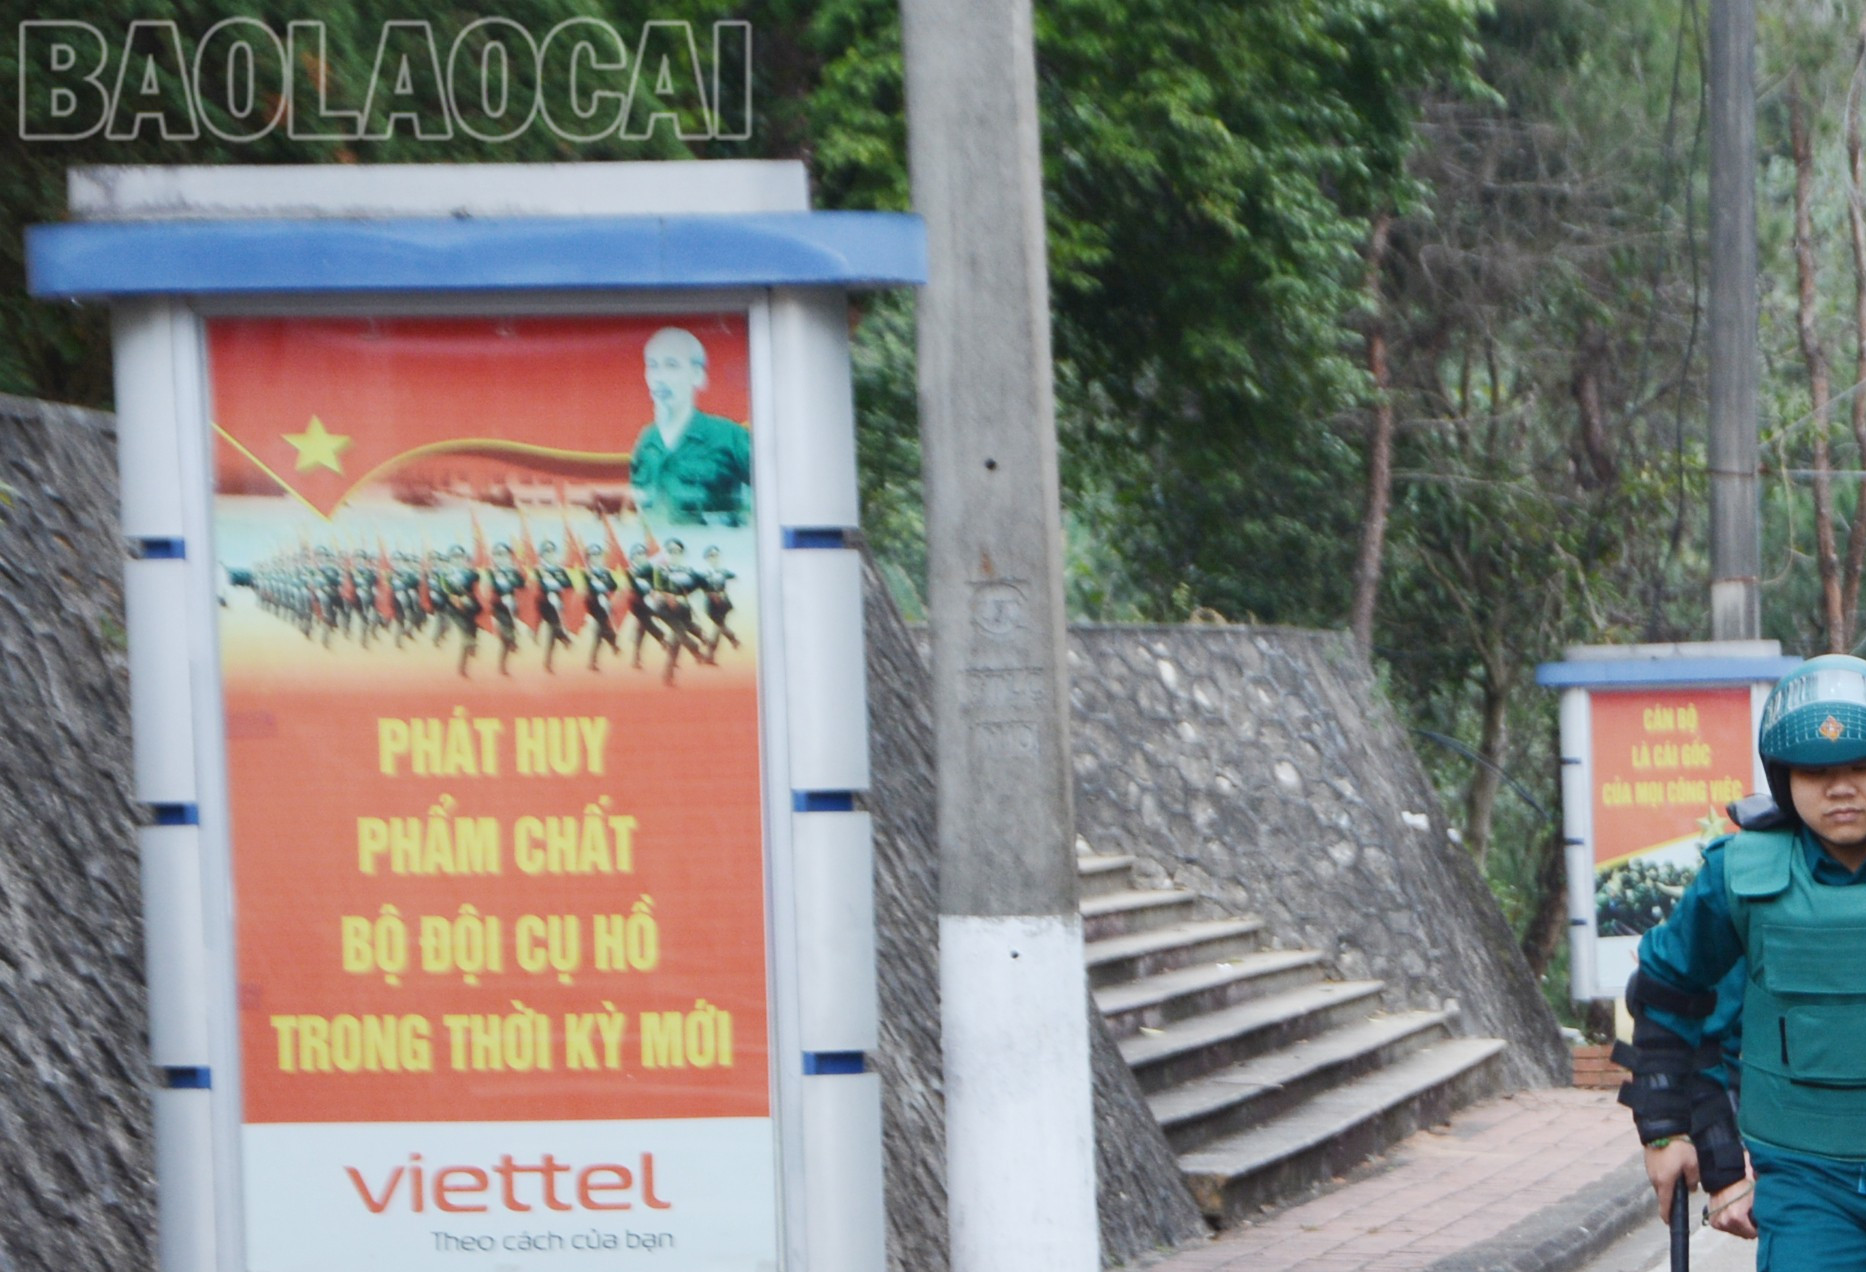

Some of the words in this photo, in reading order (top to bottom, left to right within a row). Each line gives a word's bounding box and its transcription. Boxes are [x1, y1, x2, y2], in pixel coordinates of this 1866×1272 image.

[377, 705, 503, 776] PHÁT
[515, 716, 609, 776] HUY
[356, 793, 500, 876] PHẨM
[513, 795, 638, 875] CHẤT
[341, 902, 408, 986] BỘ
[419, 902, 503, 986] ĐỘI
[515, 914, 581, 986] CỤ
[593, 893, 660, 973] HỒ
[270, 1014, 433, 1072] TRONG
[442, 999, 552, 1072] THỜI
[564, 1000, 626, 1071] KỲ
[639, 998, 734, 1069] MỚI
[342, 1151, 673, 1214] viettel
[430, 1230, 495, 1252] Theo
[502, 1229, 564, 1252] cách
[571, 1228, 620, 1251] của
[624, 1228, 675, 1253] bạn
